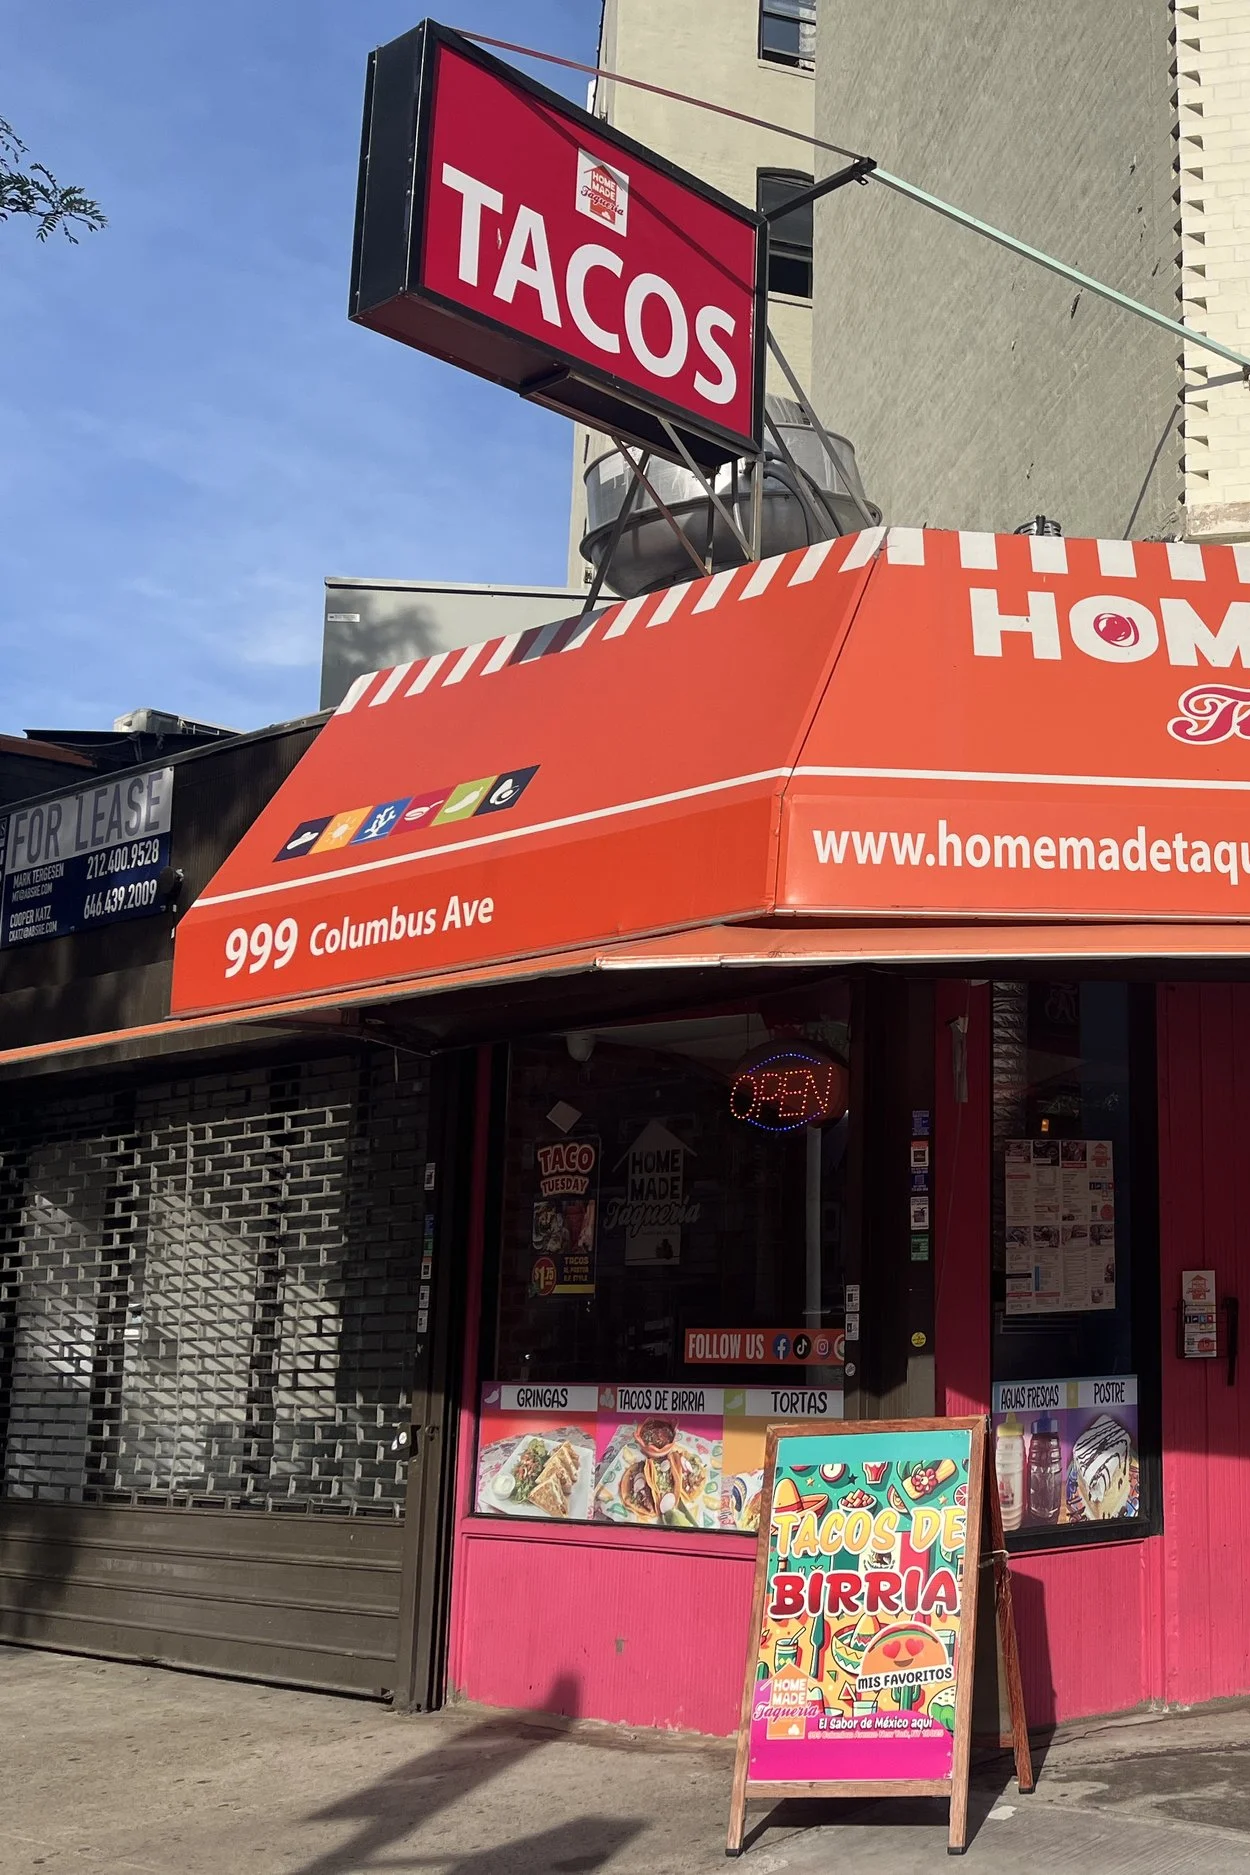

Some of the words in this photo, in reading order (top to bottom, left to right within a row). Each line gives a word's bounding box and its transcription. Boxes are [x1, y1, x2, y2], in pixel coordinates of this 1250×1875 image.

[592, 171, 616, 192] HOME
[592, 181, 616, 202] MADE
[441, 162, 737, 405] TACOS
[11, 803, 62, 869] FOR
[75, 772, 163, 851] LEASE
[86, 838, 160, 880] 212.400.9528
[13, 872, 31, 889] MARK
[83, 879, 158, 920] 646.439.2009
[9, 909, 34, 928] COOPER
[35, 905, 51, 922] KATZ
[224, 917, 299, 979] 999
[309, 908, 437, 957] Columbus
[442, 895, 495, 931] Ave
[730, 1066, 833, 1119] OPEN
[538, 1145, 595, 1176] TACO
[630, 1150, 681, 1174] HOME
[541, 1177, 589, 1196] TUESDAY
[629, 1176, 681, 1201] MADE
[688, 1334, 741, 1360] FOLLOW
[745, 1334, 764, 1360] US
[517, 1388, 568, 1408] GRINGAS
[618, 1389, 652, 1411] TACOS
[655, 1390, 668, 1411] DE
[671, 1390, 705, 1412] BIRRIA
[770, 1391, 828, 1415] TORTAS
[1001, 1387, 1026, 1410] AGUAS
[1027, 1384, 1060, 1409] FRESCAS
[1094, 1381, 1126, 1405] POSTRE
[772, 1509, 896, 1557] TACOS
[913, 1509, 966, 1551] DE
[770, 1570, 958, 1617] BIRRIA
[774, 1679, 806, 1691] HOME
[858, 1678, 881, 1691] MIS
[884, 1667, 952, 1686] FAVORITOS
[772, 1692, 806, 1705] MADE
[819, 1718, 827, 1729] El
[832, 1717, 859, 1729] Sabor
[862, 1716, 872, 1728] de
[876, 1714, 908, 1728] México
[911, 1715, 933, 1731] aquí
